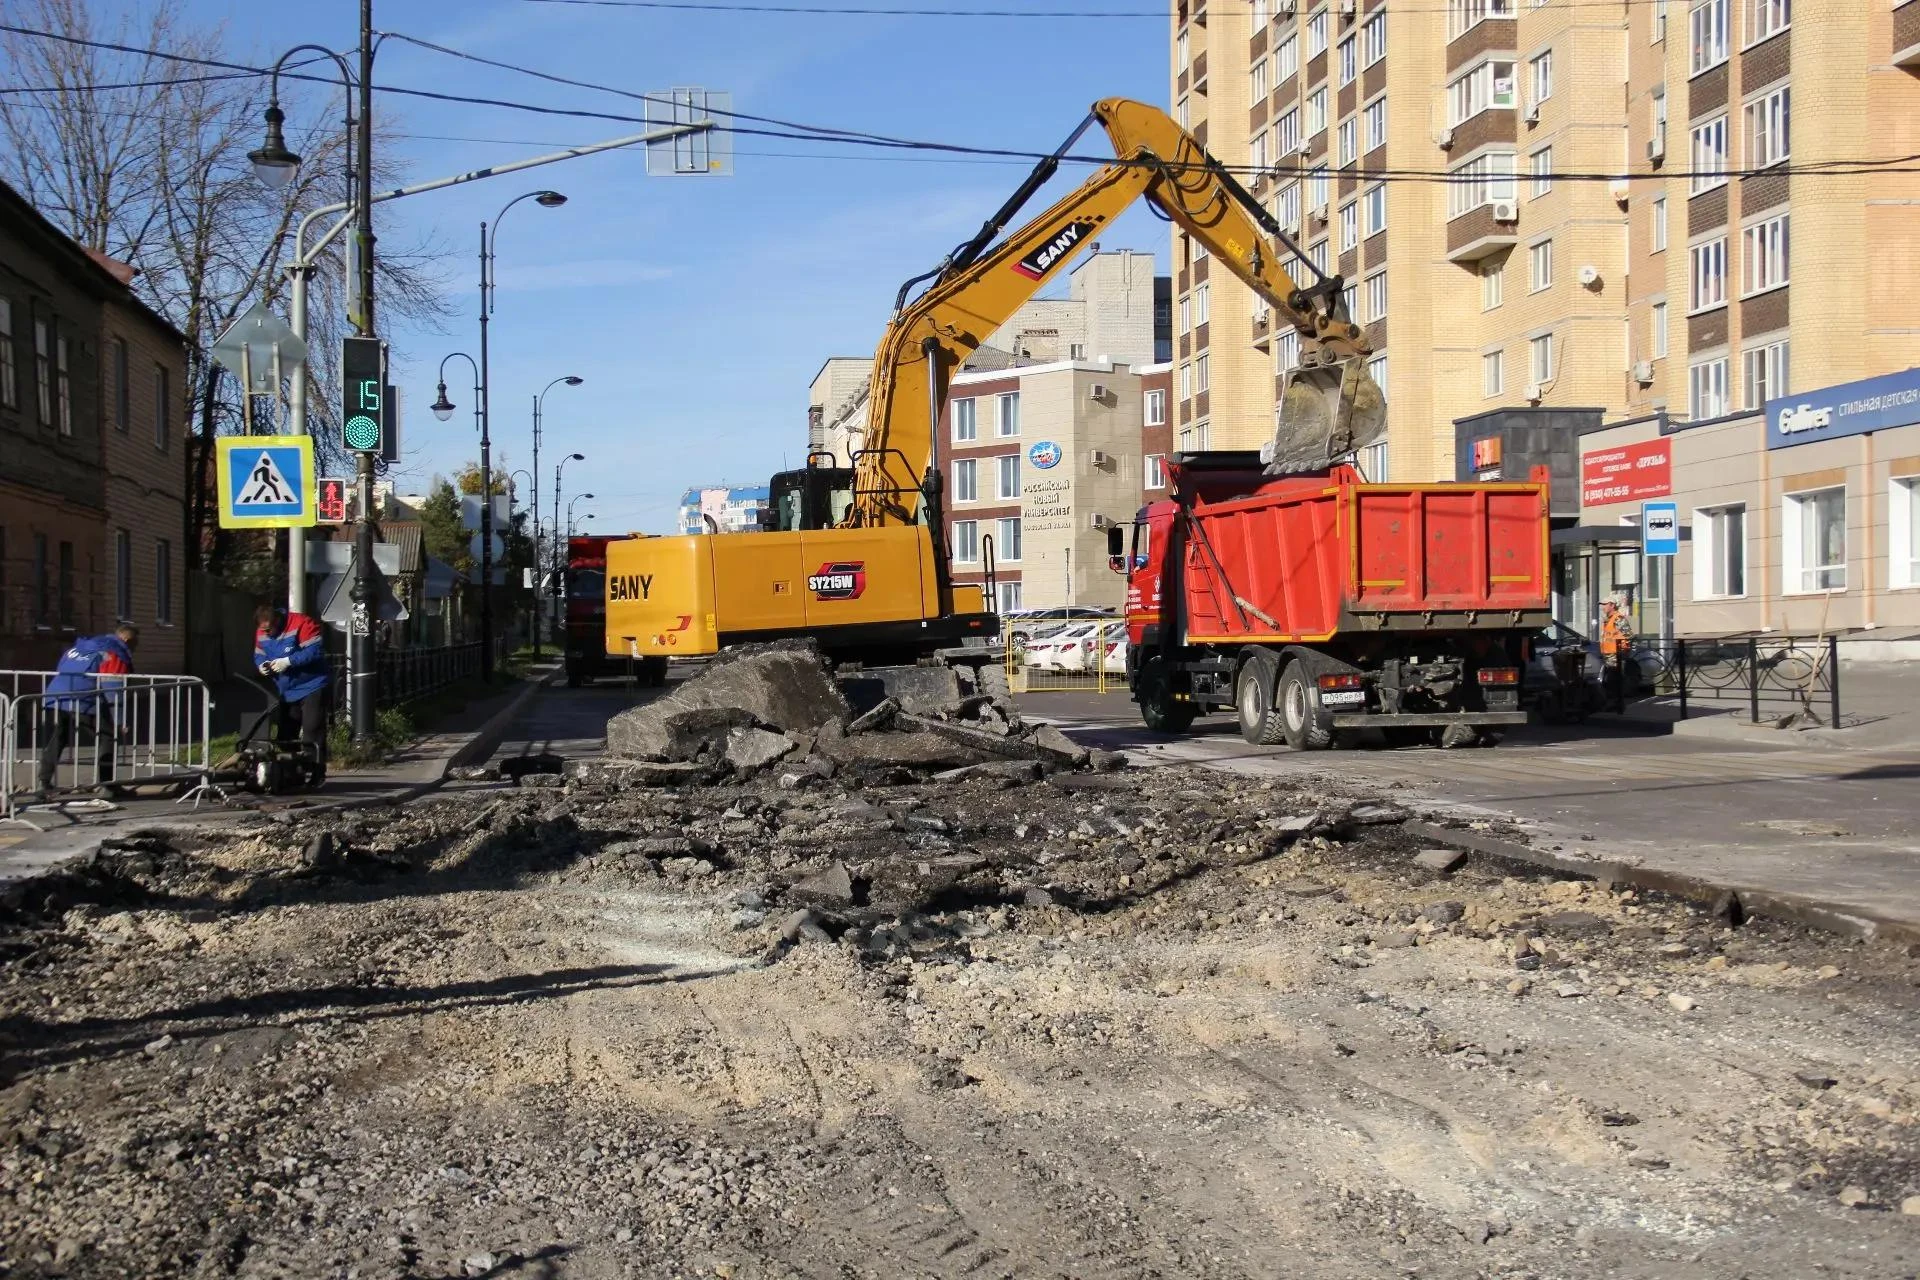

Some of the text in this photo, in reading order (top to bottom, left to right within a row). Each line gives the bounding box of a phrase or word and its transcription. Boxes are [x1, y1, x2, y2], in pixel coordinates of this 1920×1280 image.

[1037, 224, 1078, 270] SANY
[359, 380, 380, 411] 15
[1839, 389, 1918, 417] стильная детская
[1023, 479, 1070, 493] РОССИЙСКИЙ
[1032, 492, 1060, 505] НОВЫЙ
[319, 500, 344, 520] 43
[1023, 506, 1070, 518] УНИВЕРСИТЕТ
[610, 574, 654, 601] SANY
[808, 574, 853, 591] SY215W
